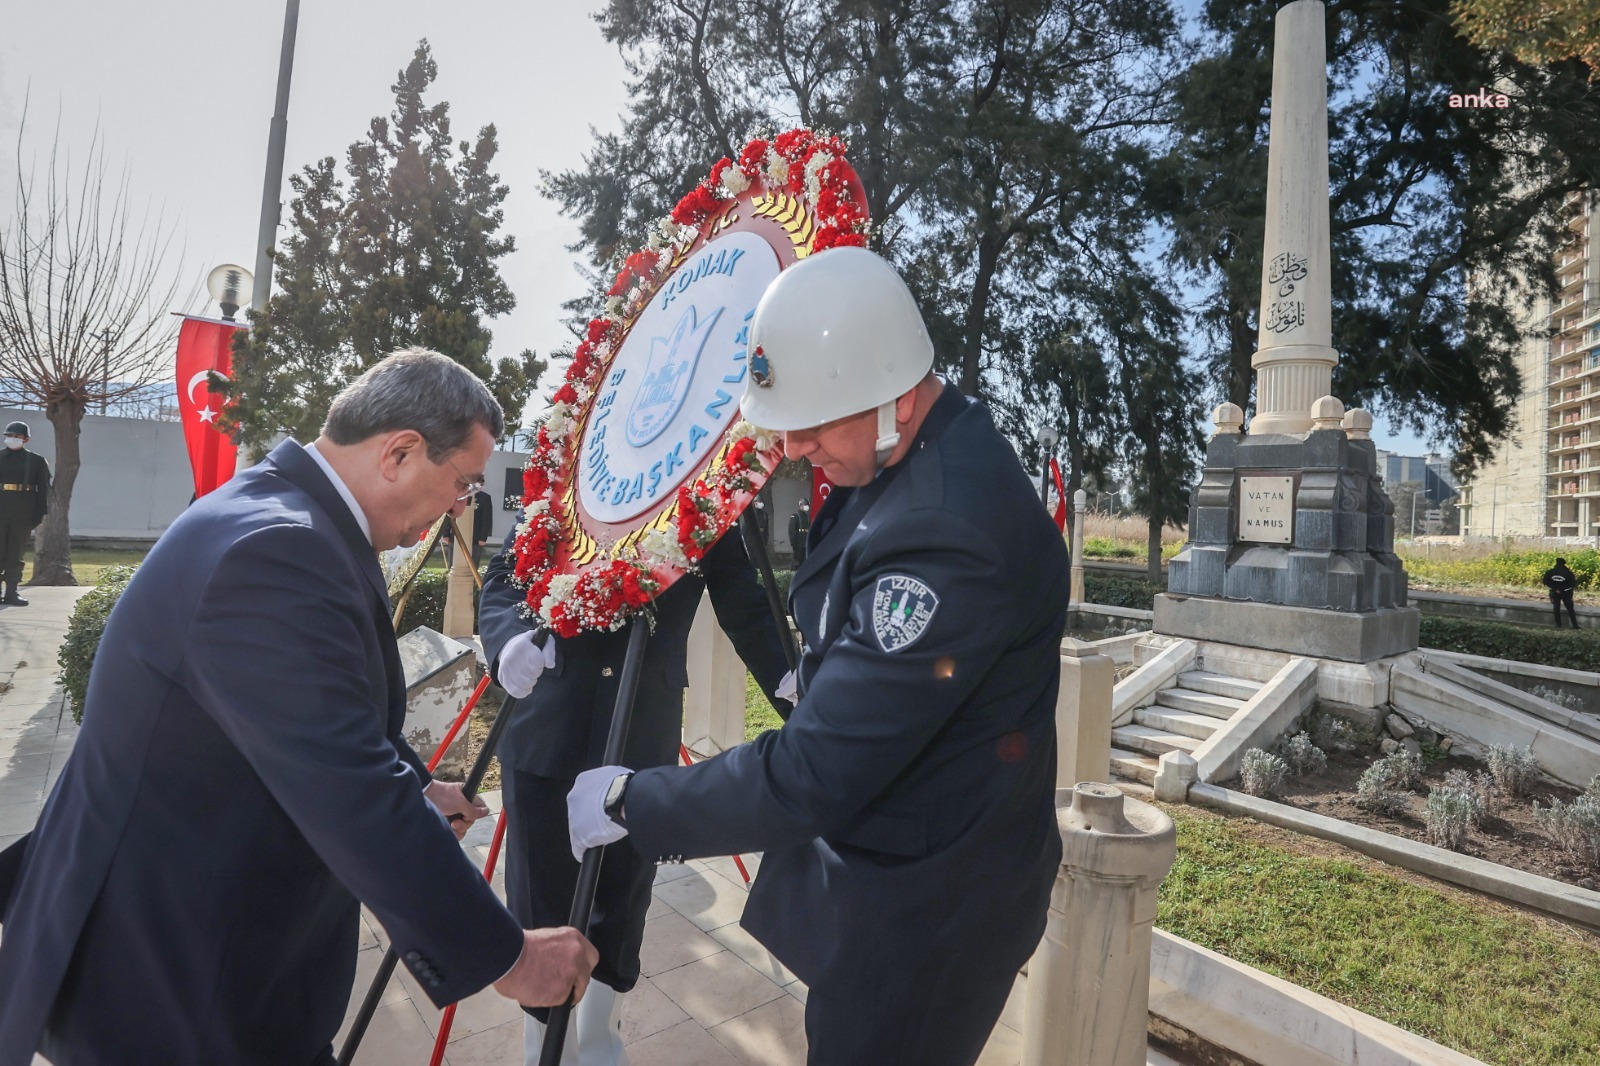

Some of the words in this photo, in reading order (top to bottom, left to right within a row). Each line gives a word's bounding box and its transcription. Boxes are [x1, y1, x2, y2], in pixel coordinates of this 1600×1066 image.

[661, 248, 745, 310] KONAK
[1248, 492, 1284, 500] VATAN
[1247, 519, 1284, 528] NAMUS
[880, 589, 893, 624] KONAK
